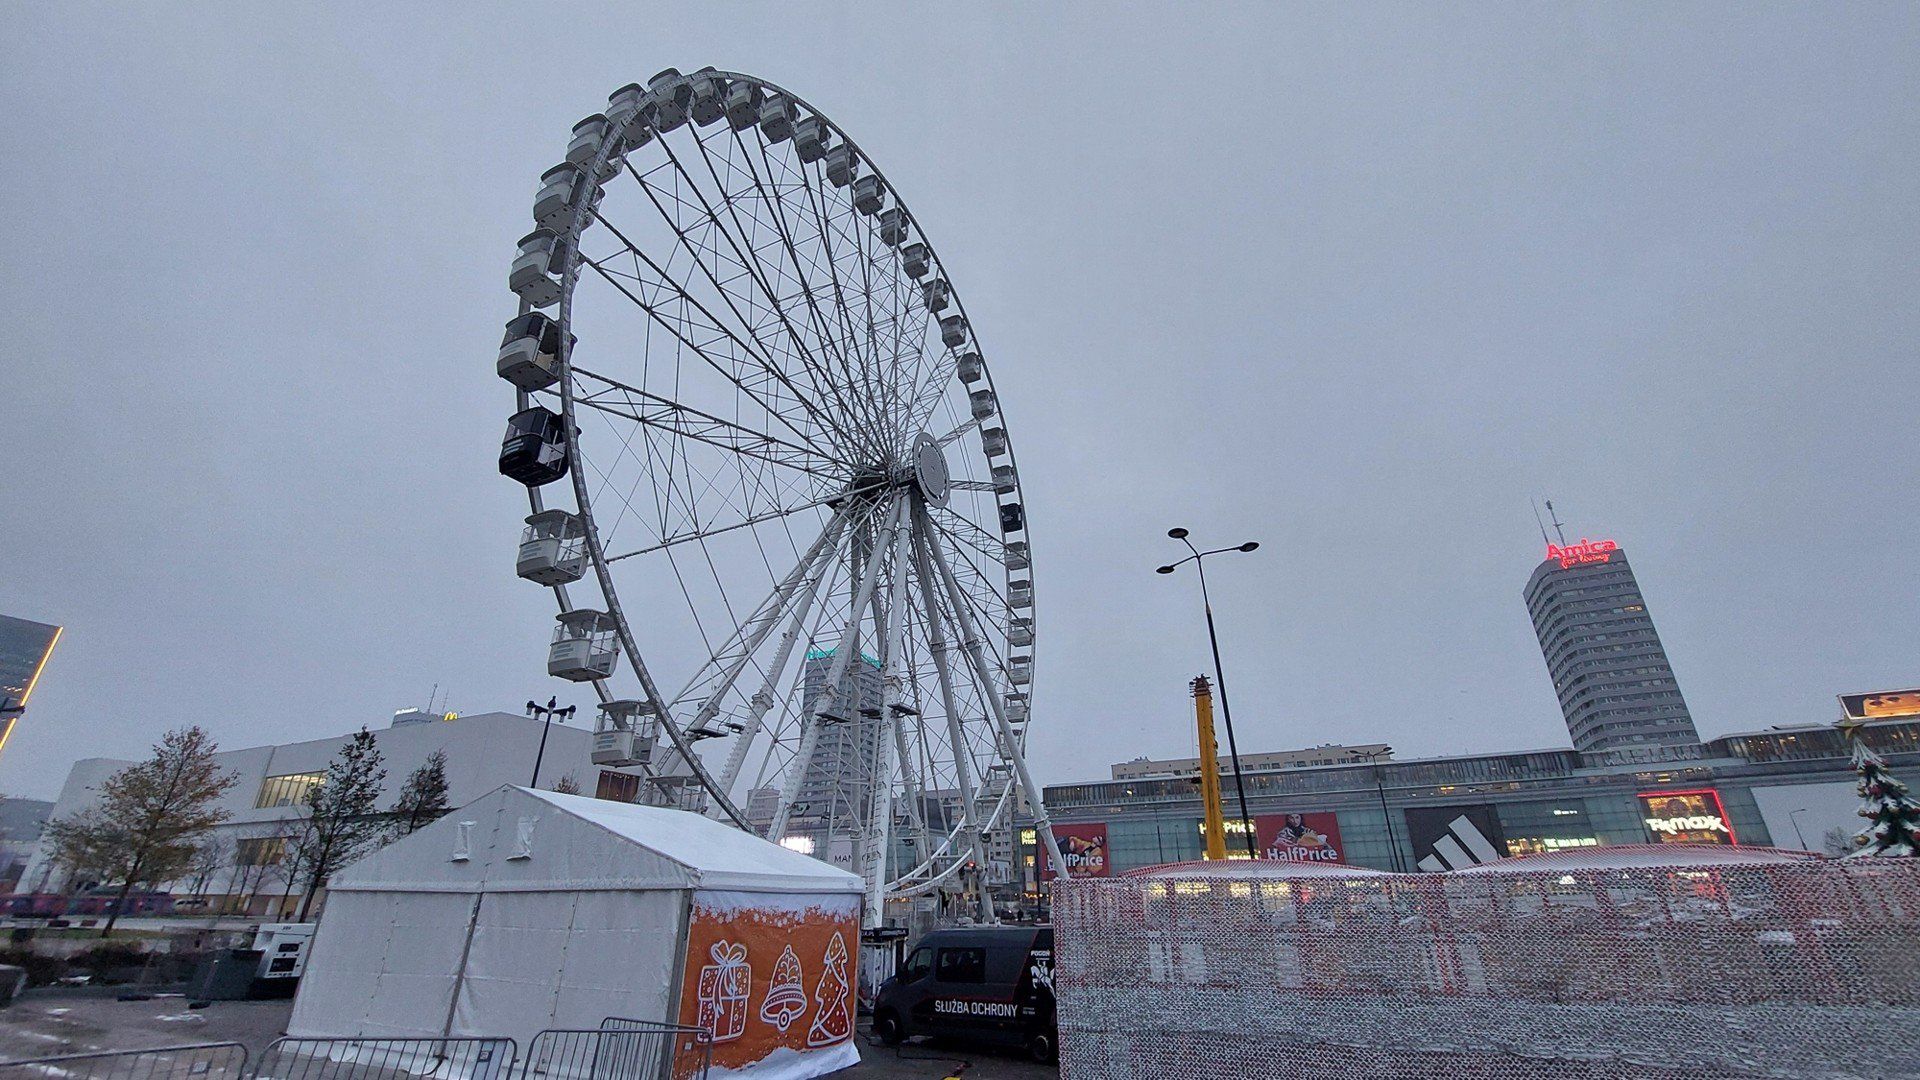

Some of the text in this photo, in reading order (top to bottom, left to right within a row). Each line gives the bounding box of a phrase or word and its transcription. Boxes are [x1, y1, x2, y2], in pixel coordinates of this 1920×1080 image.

[1547, 538, 1617, 560] Amica
[1562, 553, 1610, 569] for living
[1047, 853, 1103, 871] HlfPrice
[1266, 846, 1338, 861] HalfPrice
[935, 998, 970, 1014] SŁUŻBA
[971, 1002, 1018, 1018] OCHRONY
